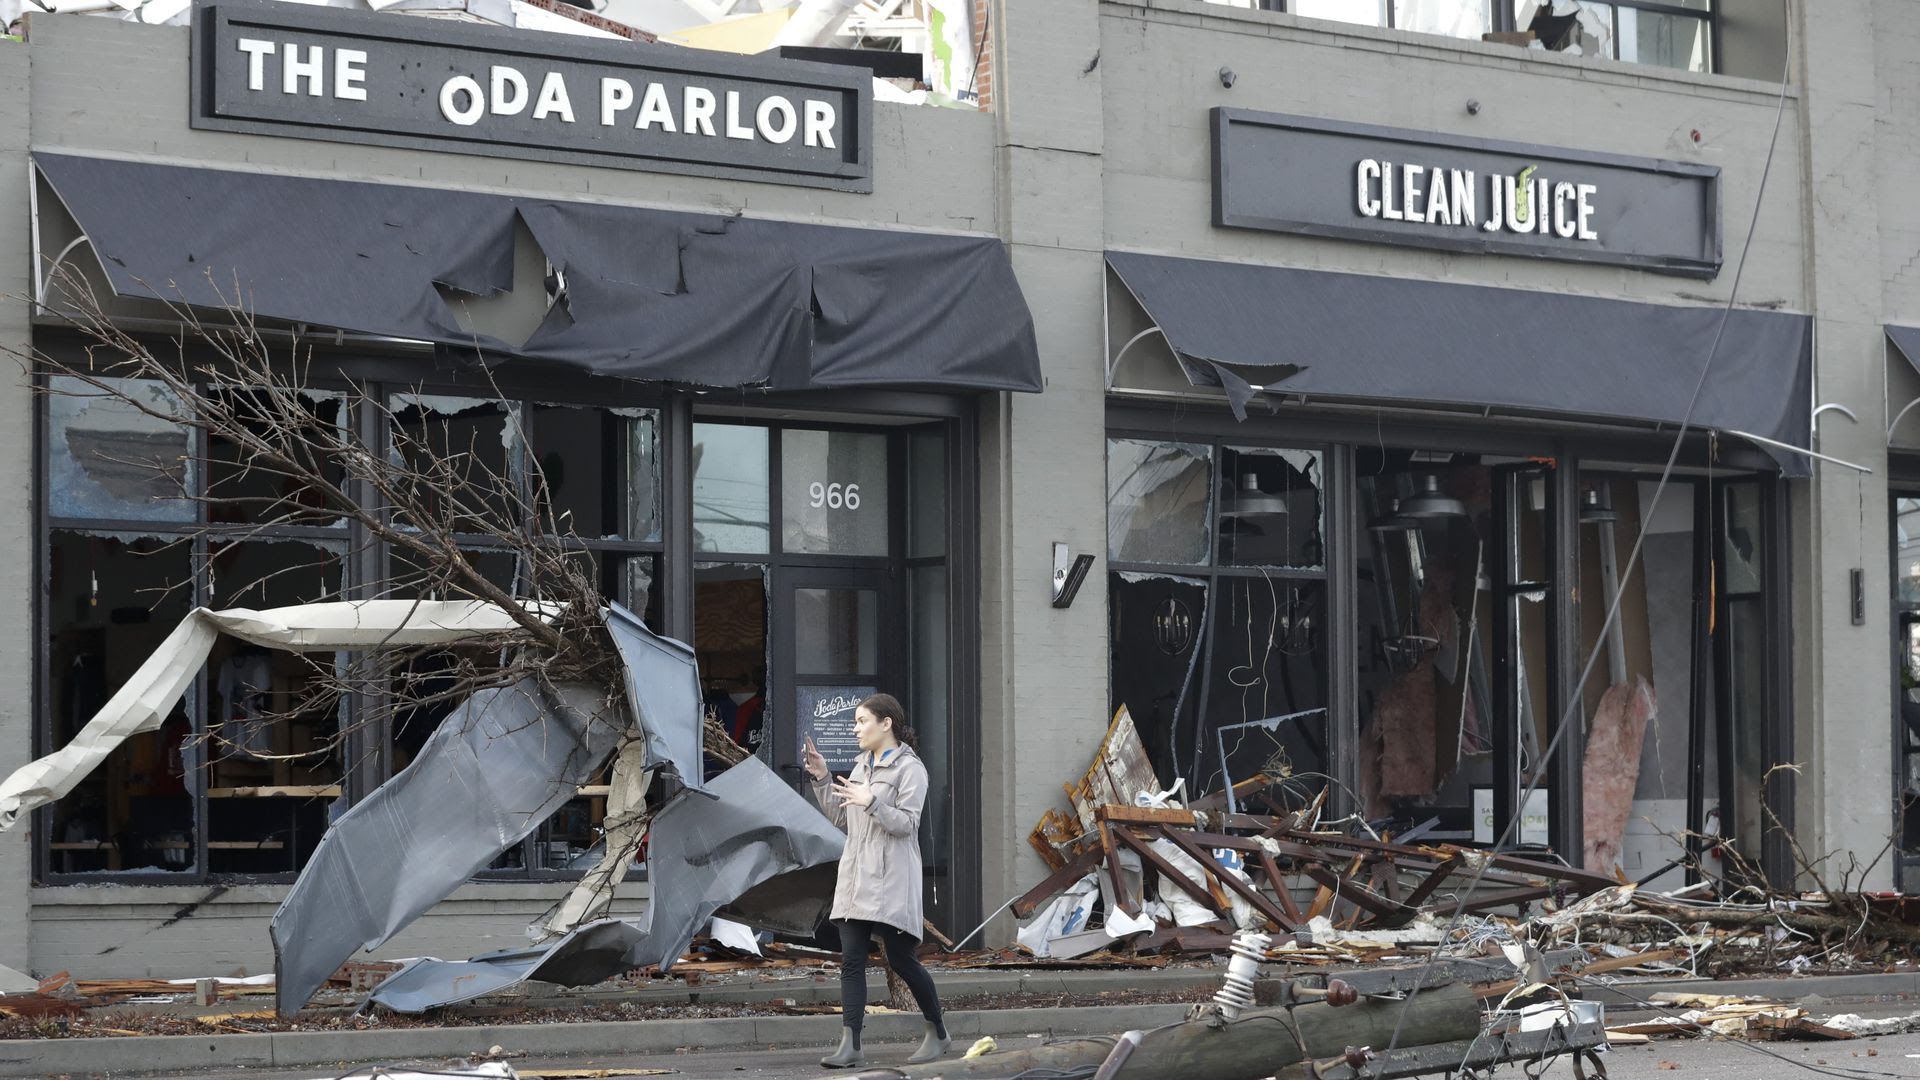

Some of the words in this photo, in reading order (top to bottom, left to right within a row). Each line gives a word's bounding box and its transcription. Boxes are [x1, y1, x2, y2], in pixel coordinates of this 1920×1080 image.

[237, 38, 367, 101] THE
[440, 66, 575, 126] ODA
[600, 77, 836, 149] PARLOR
[1357, 158, 1475, 227] CLEAN
[1483, 167, 1598, 240] JUICE
[809, 481, 860, 510] 966
[814, 698, 837, 717] Soda
